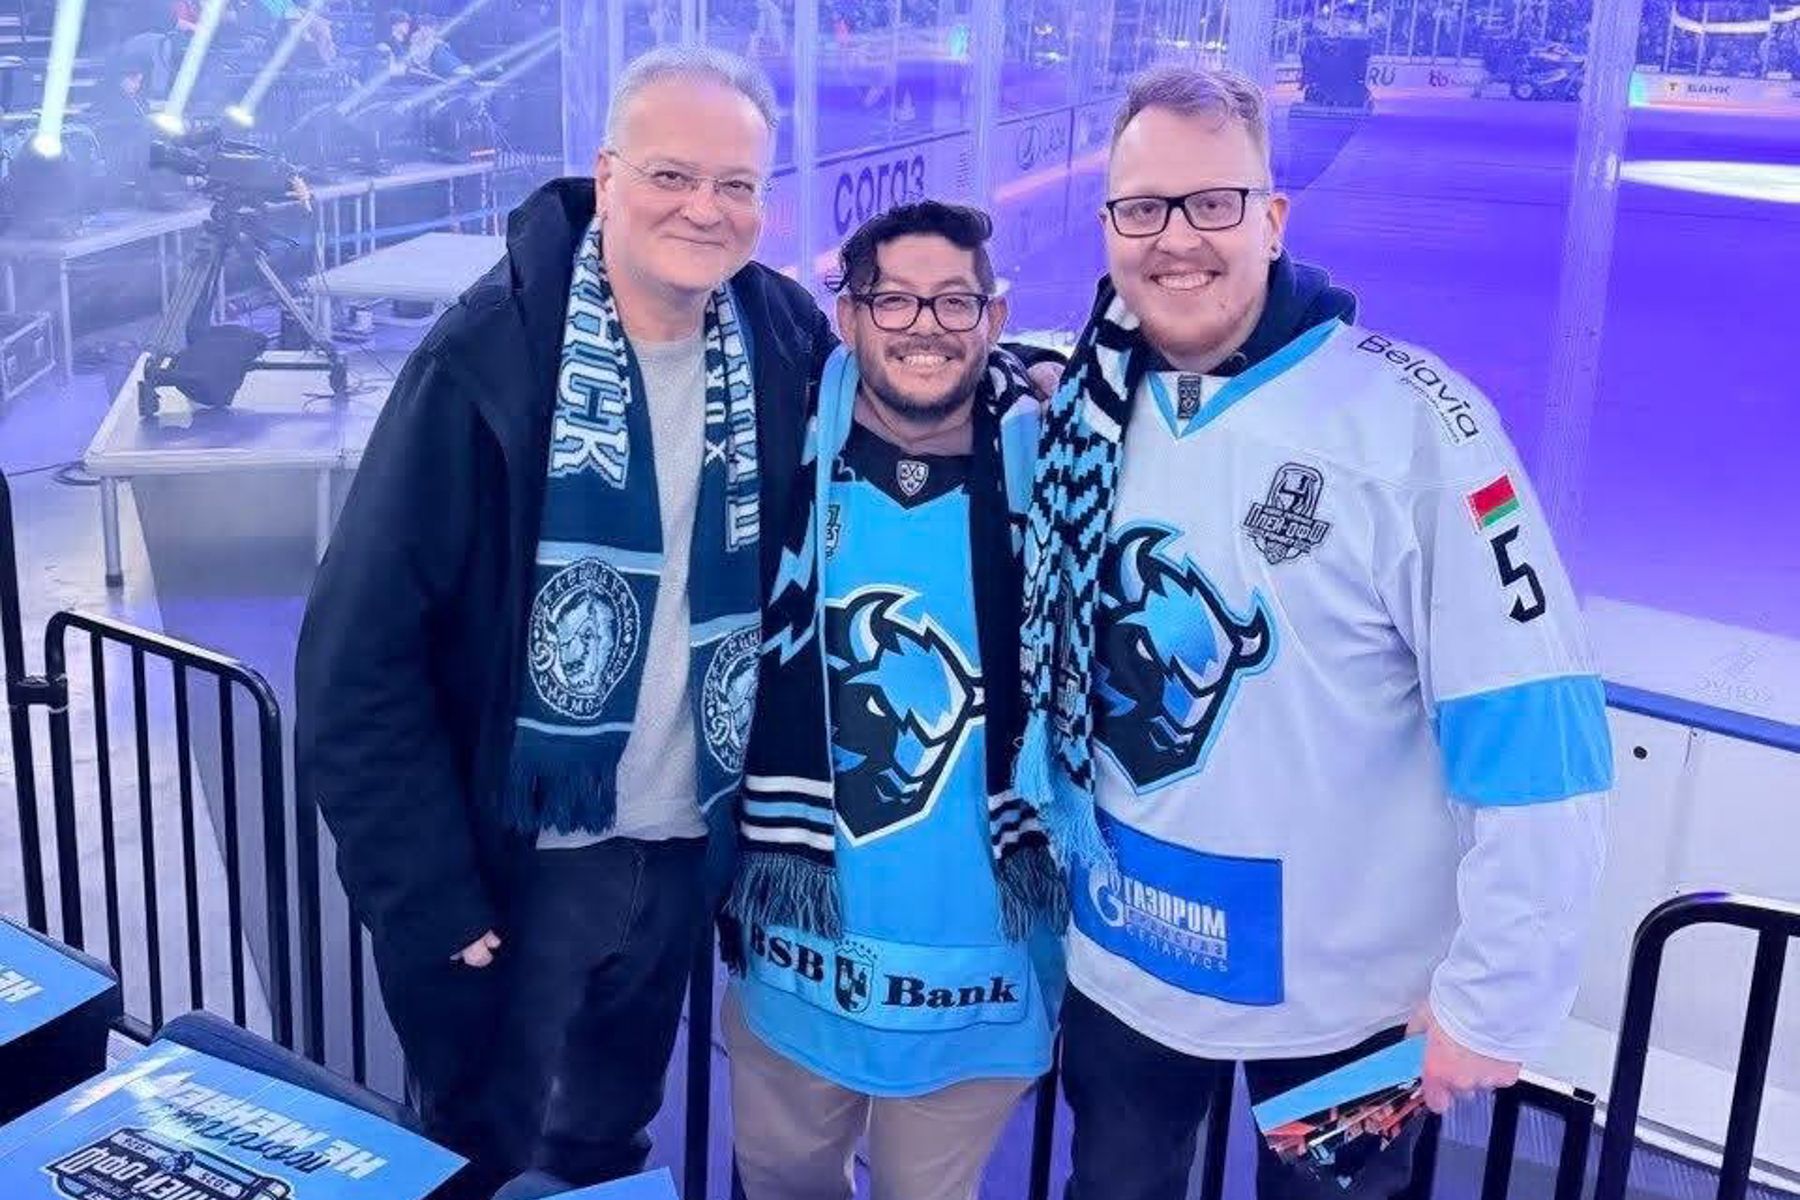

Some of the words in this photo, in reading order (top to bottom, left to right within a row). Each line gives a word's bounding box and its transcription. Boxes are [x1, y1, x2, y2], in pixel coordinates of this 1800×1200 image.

[1356, 334, 1479, 438] Belavia
[1489, 524, 1546, 623] 5
[1123, 873, 1227, 939] ГАЗПРОМ
[881, 973, 1019, 1009] Bank
